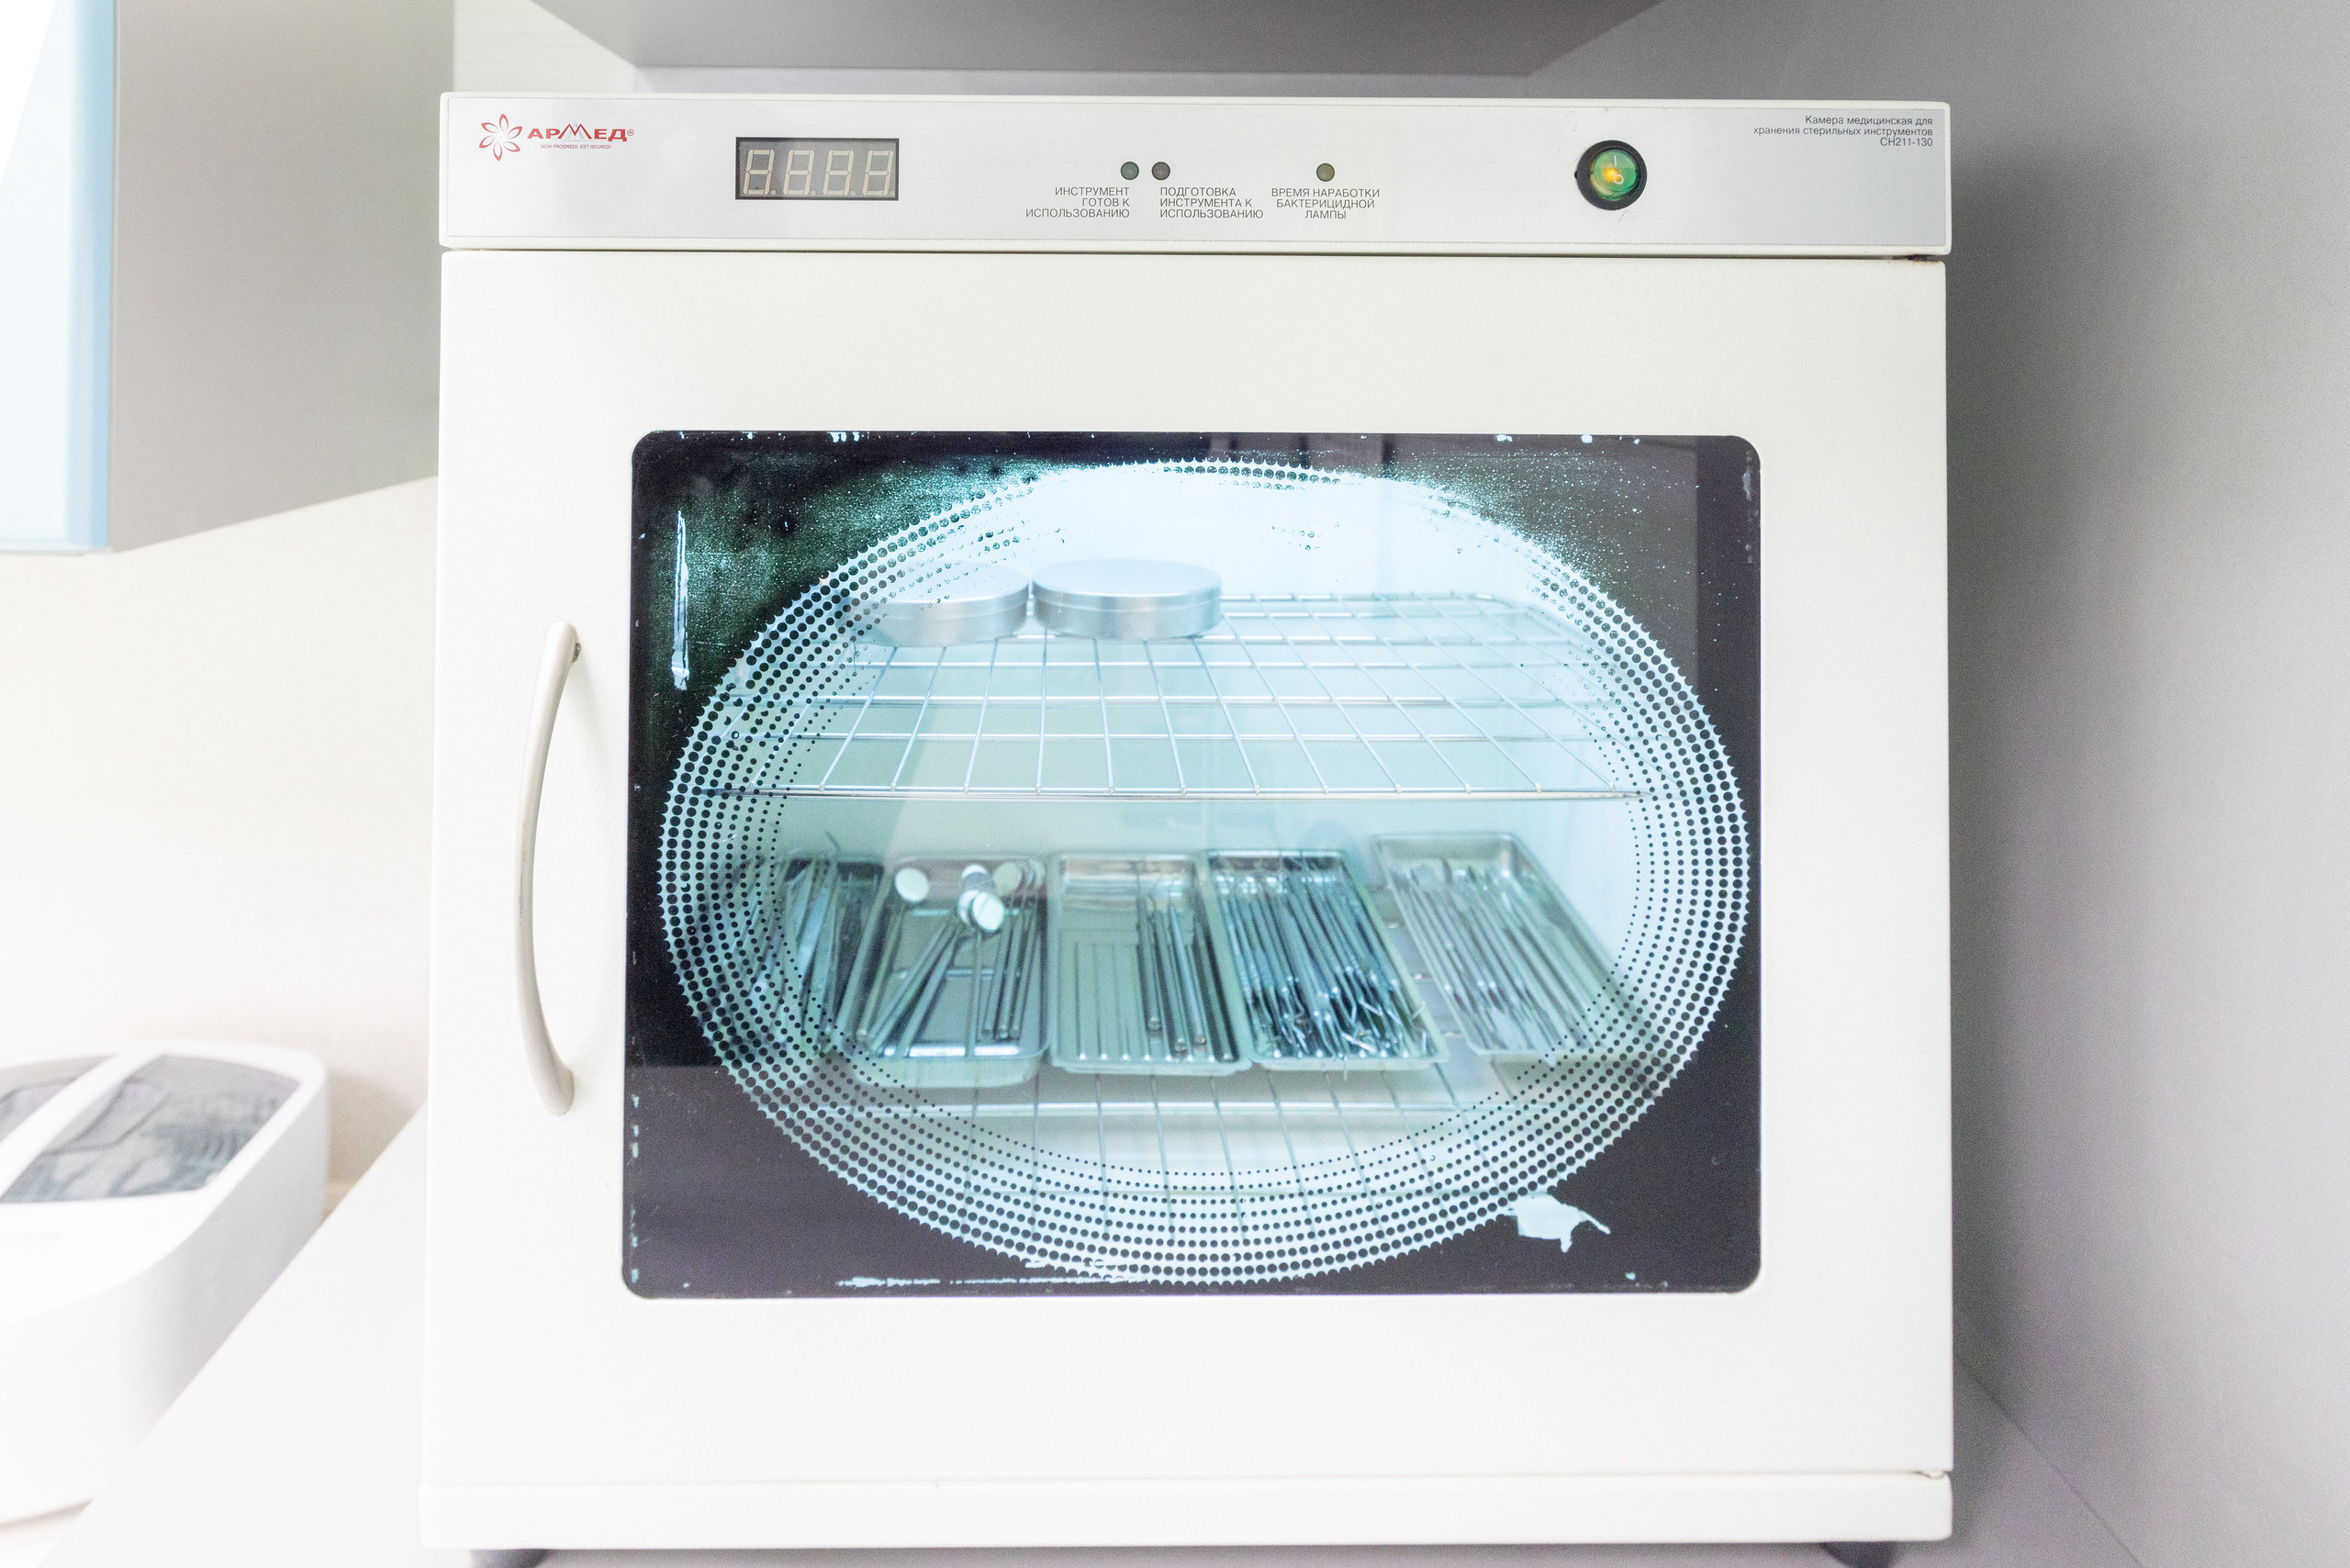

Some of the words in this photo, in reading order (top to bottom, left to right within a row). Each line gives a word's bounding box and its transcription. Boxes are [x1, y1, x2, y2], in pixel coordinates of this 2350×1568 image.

[1805, 115, 1844, 126] Камера
[1846, 117, 1913, 126] медицинская
[1915, 118, 1933, 127] для
[1753, 127, 1800, 136] хранения
[1803, 127, 1862, 137] стерильных
[1864, 128, 1933, 137] инструментов
[1055, 186, 1130, 196] ИНСТРУМЕНТ
[1159, 186, 1237, 197] ПОДГОТОВКА
[1270, 187, 1310, 198] ВРЕМЯ
[1313, 187, 1381, 198] НАРАБОТКИ
[1081, 197, 1120, 207] ГОТОВ
[1122, 197, 1130, 207] К
[1159, 197, 1243, 207] ИНСТРУМЕНТА
[1245, 197, 1253, 207] К
[1275, 197, 1375, 209] БАКТЕРИЦИДНОЙ
[1025, 207, 1130, 218] ИСПОЛЬЗОВАНИЮ
[1159, 208, 1264, 219] ИСПОЛЬЗОВАНИЮ
[1304, 209, 1348, 219] ЛАМПЫ
